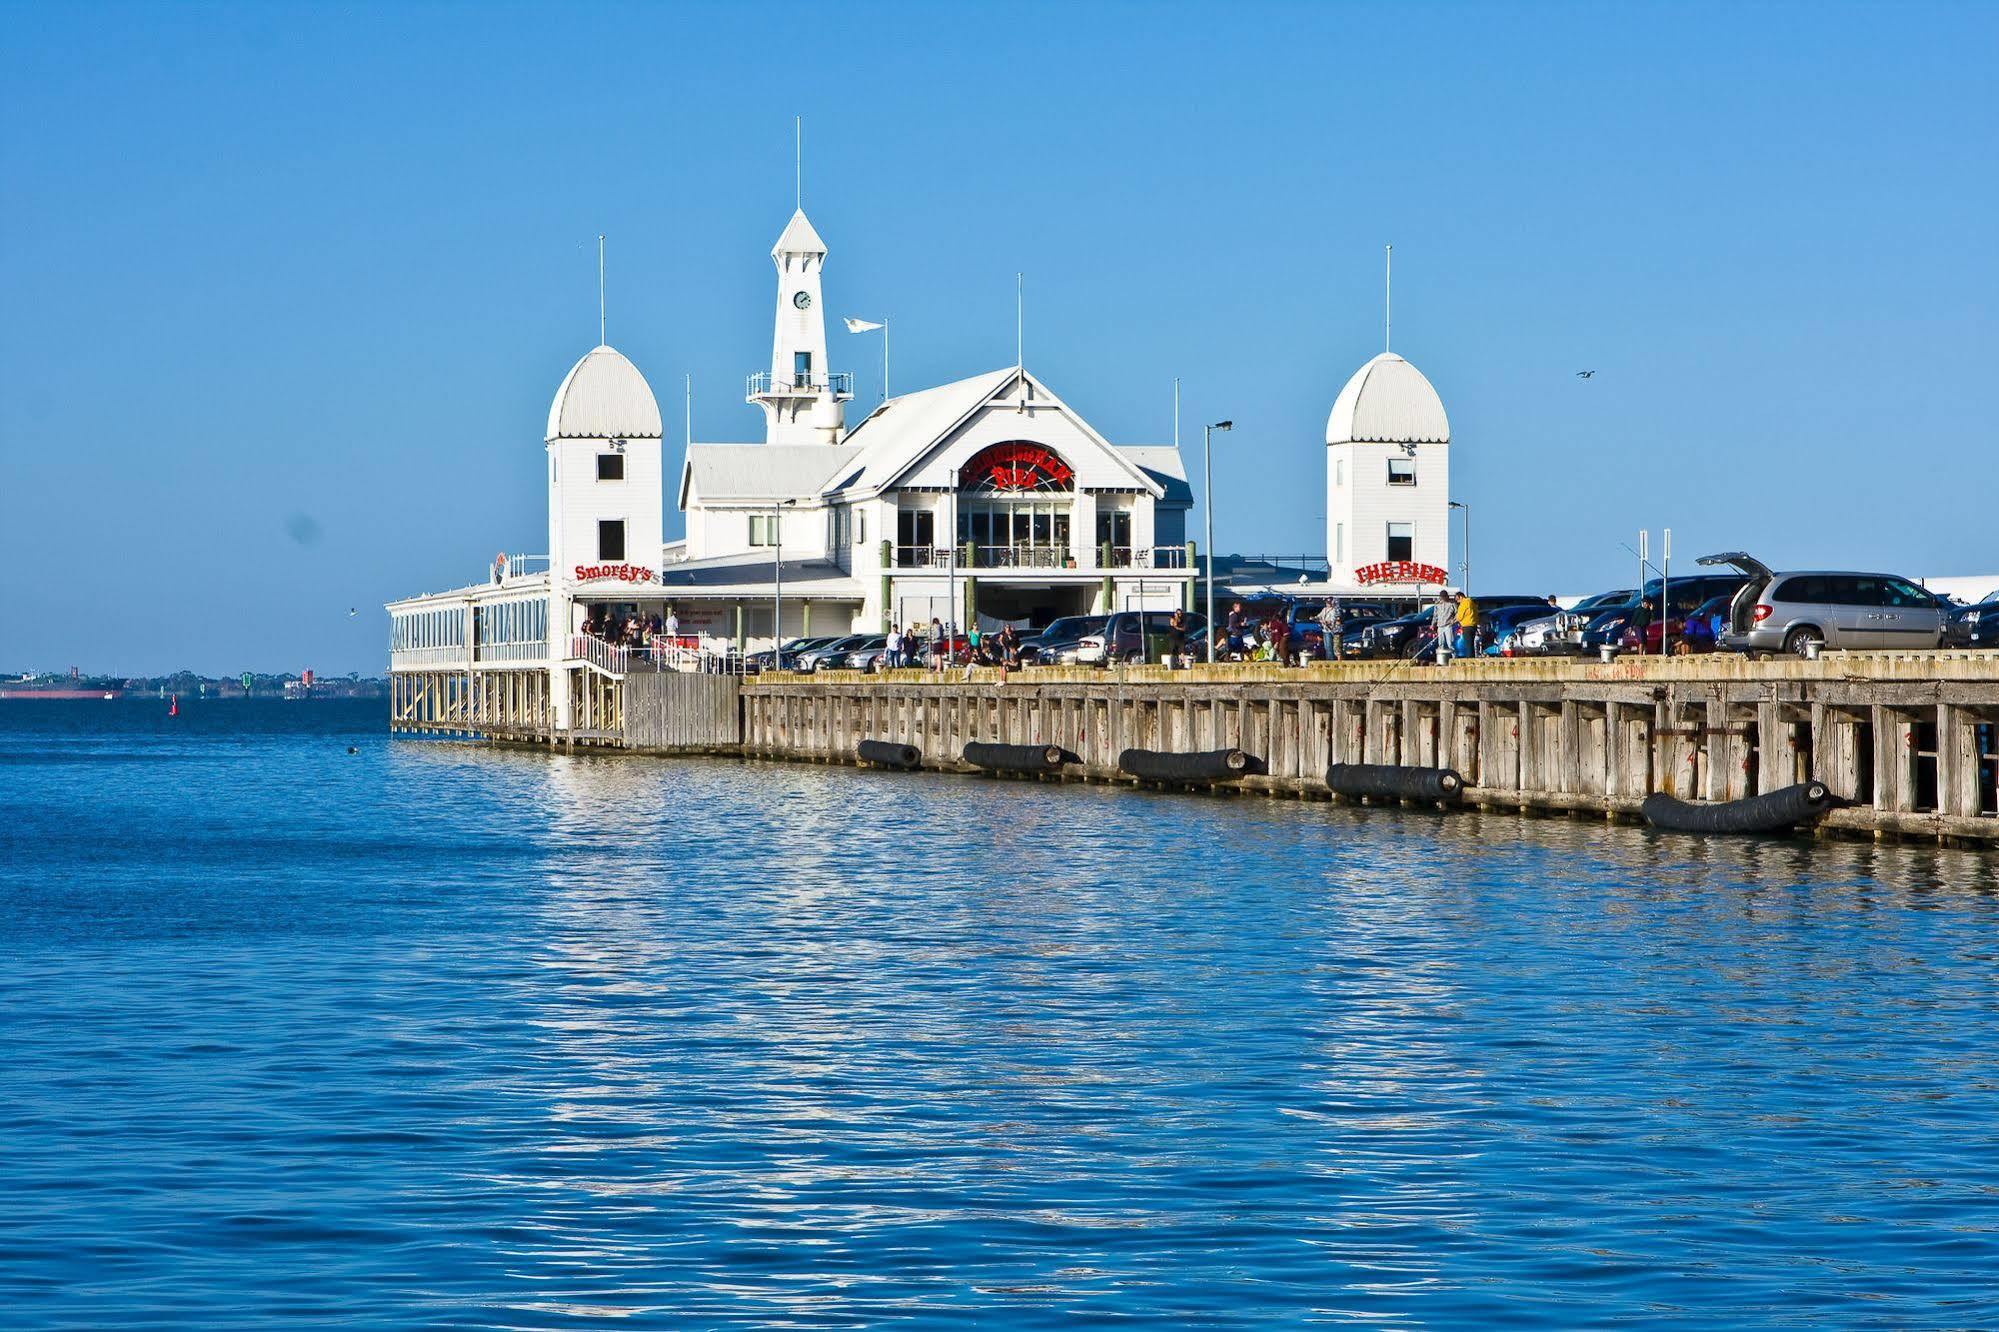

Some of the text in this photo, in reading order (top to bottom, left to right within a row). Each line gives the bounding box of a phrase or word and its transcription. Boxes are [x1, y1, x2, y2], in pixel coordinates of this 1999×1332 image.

[575, 563, 652, 581] Smorgy's
[1355, 560, 1446, 585] THE PIER
